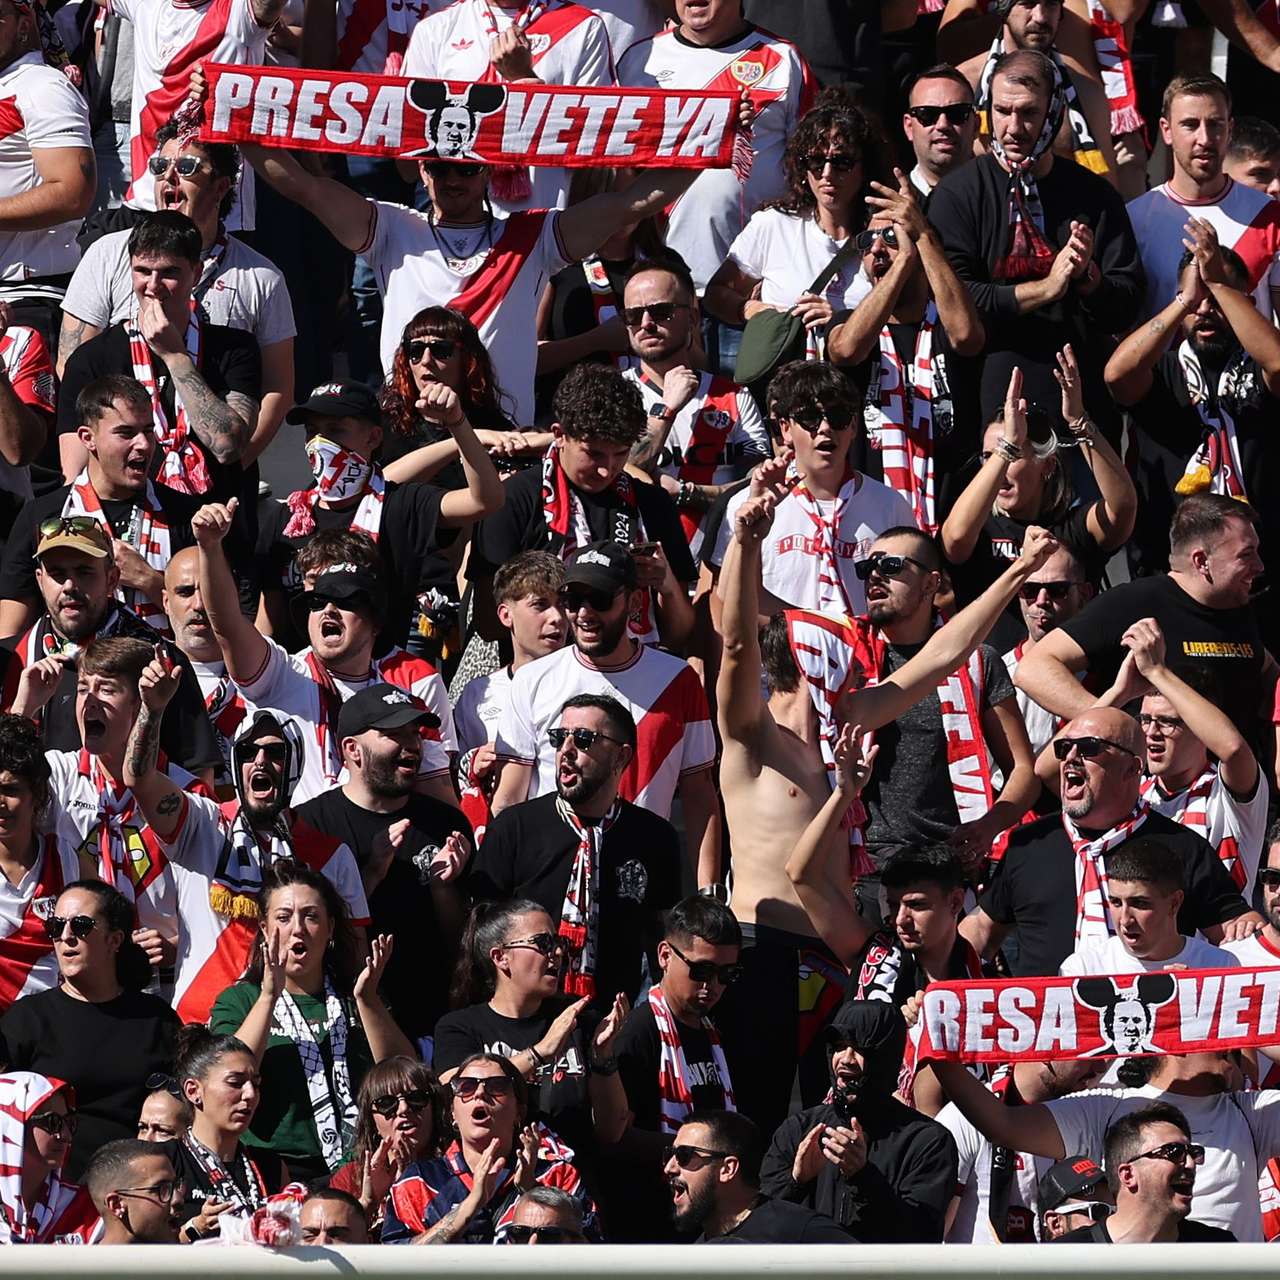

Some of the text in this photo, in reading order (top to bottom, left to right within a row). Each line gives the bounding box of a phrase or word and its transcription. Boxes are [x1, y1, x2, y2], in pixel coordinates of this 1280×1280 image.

[212, 74, 732, 159] PRESA VETE YA
[921, 982, 1078, 1053] RESA
